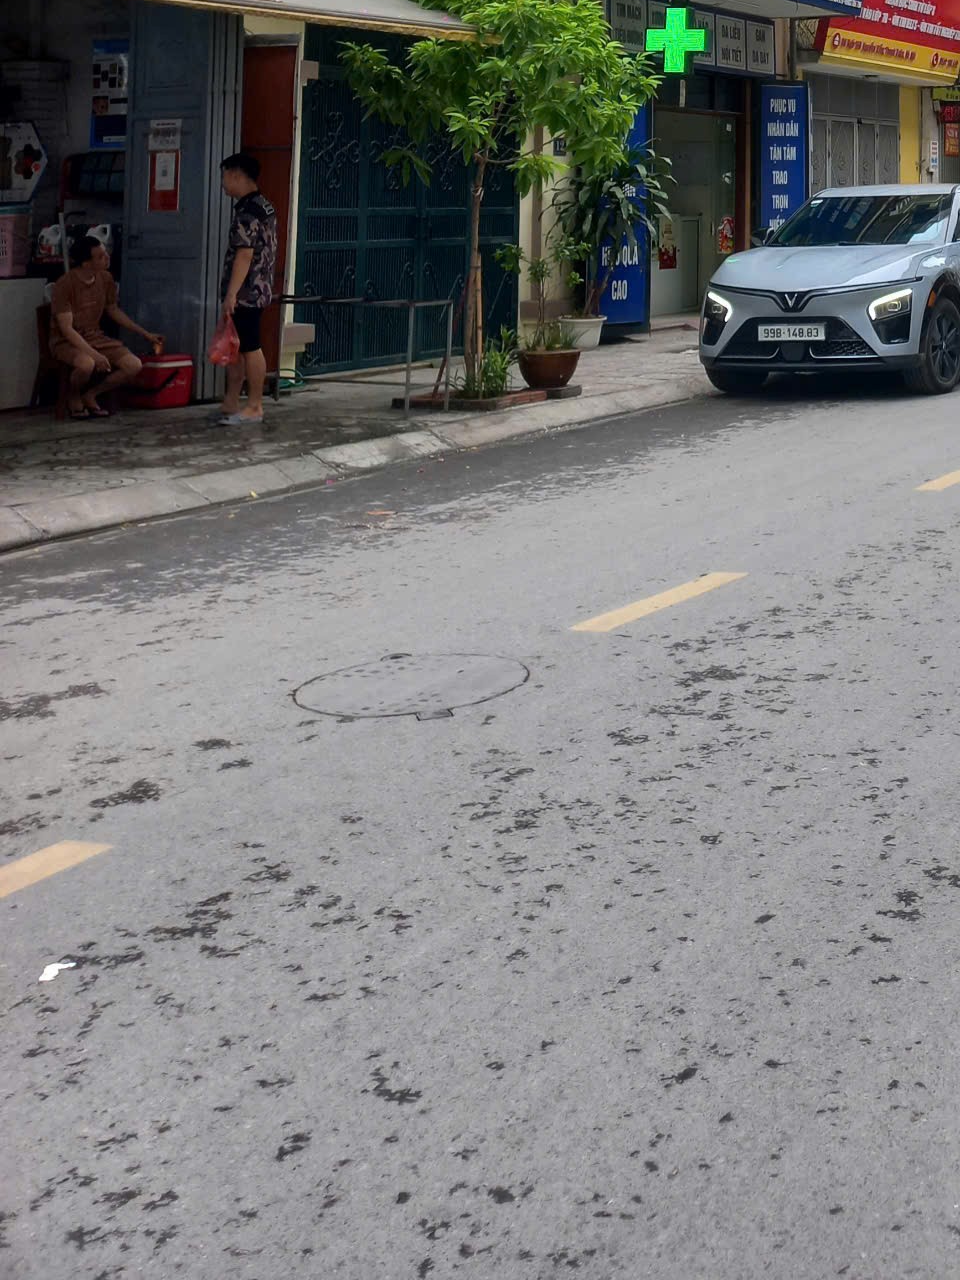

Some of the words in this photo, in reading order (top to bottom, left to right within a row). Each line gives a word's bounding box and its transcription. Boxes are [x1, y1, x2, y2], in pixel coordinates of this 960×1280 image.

[769, 99, 787, 116] PHỤC
[787, 99, 796, 116] VỤ
[767, 121, 785, 137] NHÂN
[785, 120, 799, 137] DÂN
[769, 144, 782, 164] TẬN
[783, 144, 797, 161] TÂM
[772, 170, 788, 185] TRAO
[772, 194, 789, 212] TRỌN
[611, 279, 628, 301] CAO
